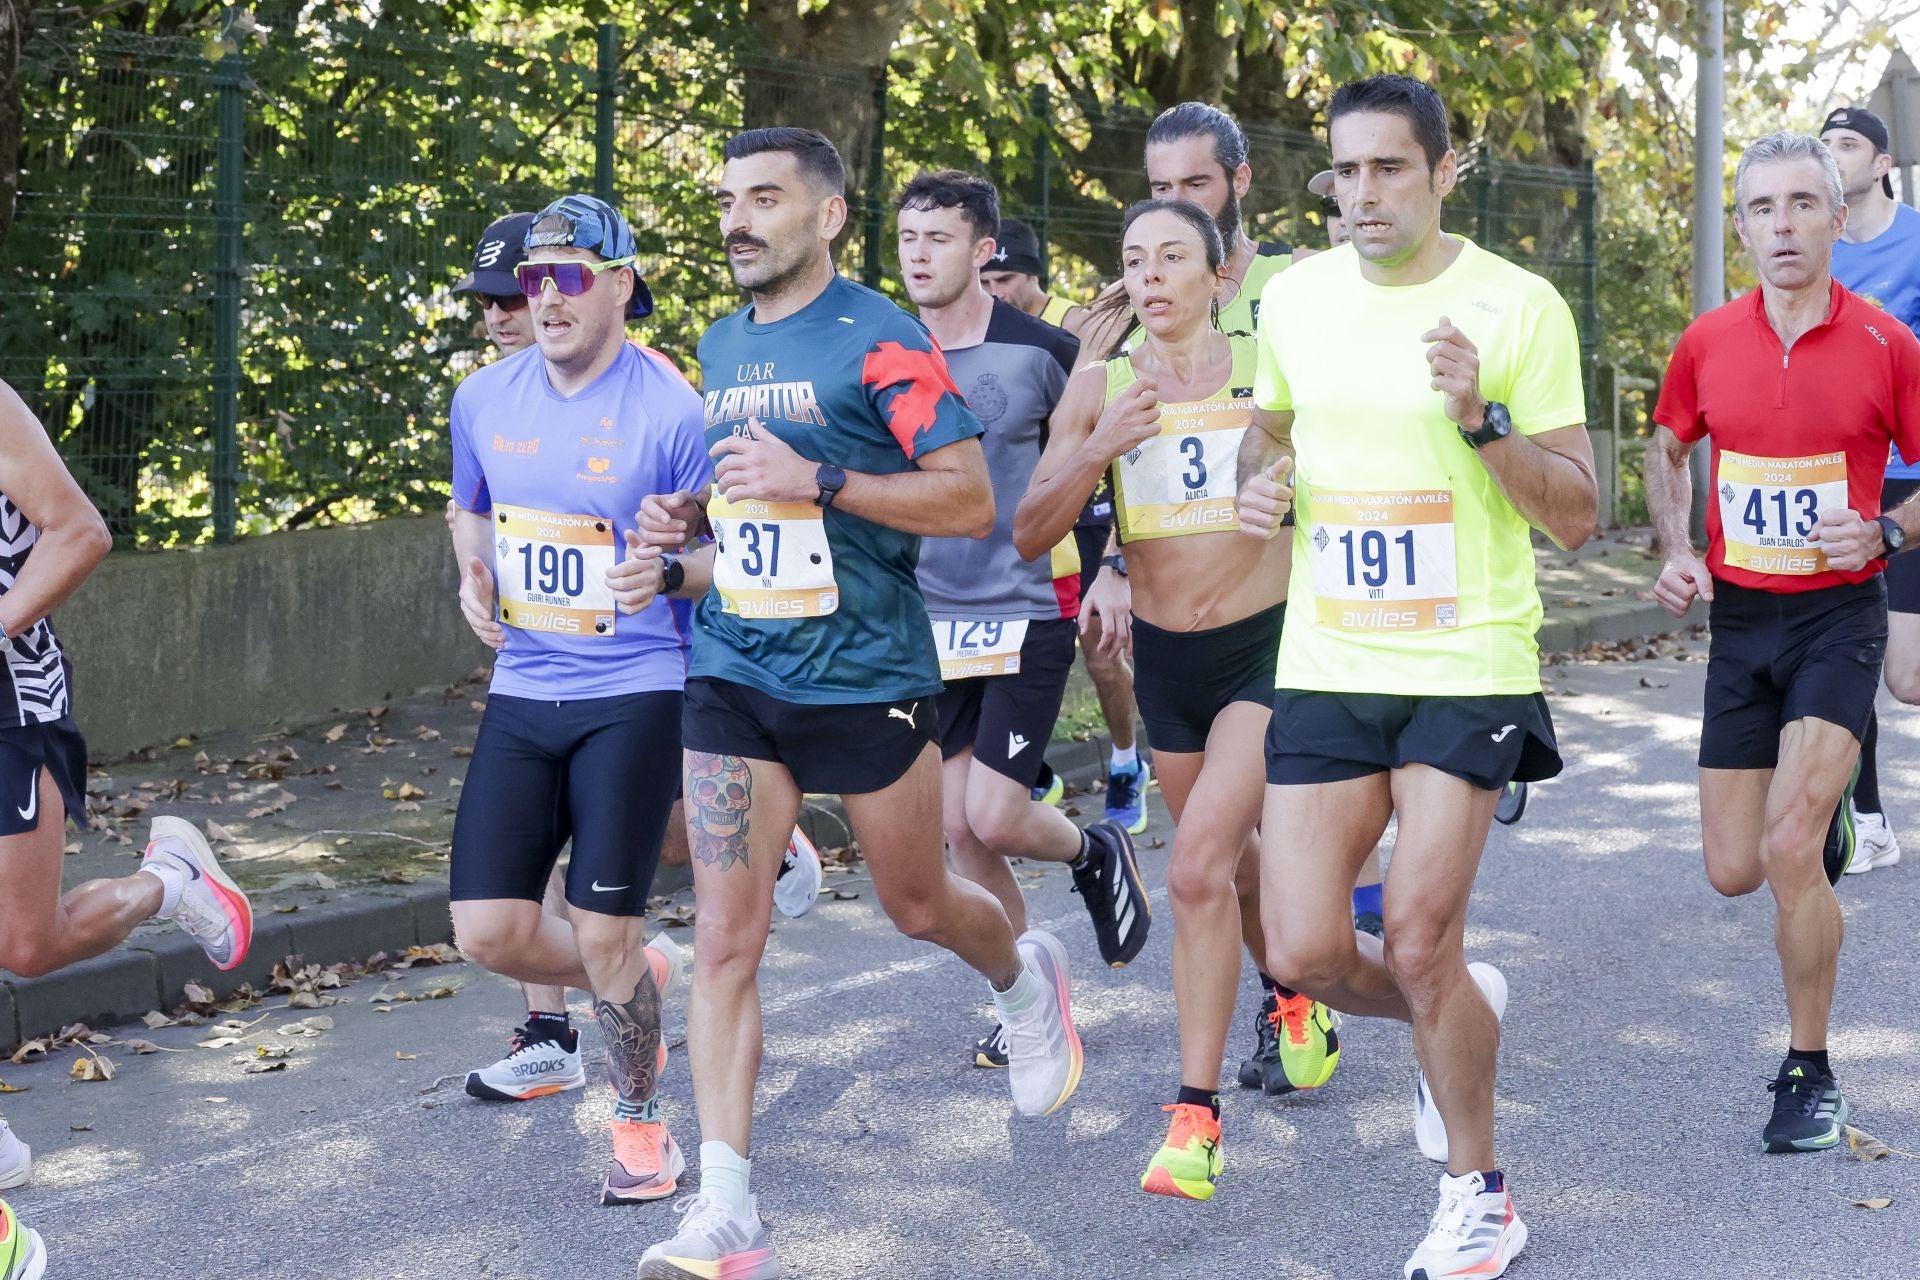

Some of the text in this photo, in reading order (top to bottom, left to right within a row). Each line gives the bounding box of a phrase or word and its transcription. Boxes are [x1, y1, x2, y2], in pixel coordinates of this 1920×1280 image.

[737, 362, 775, 382] UAR
[1161, 399, 1256, 417] DIA MARATÓN AVILÉ
[733, 422, 767, 440] RA
[1175, 419, 1205, 430] 2024
[1179, 436, 1208, 490] 3
[1743, 458, 1766, 469] MEDIA
[1767, 457, 1813, 470] MARATÓN
[1813, 454, 1843, 467] AVILÉS
[1764, 472, 1793, 483] 2024
[1185, 489, 1208, 501] ALICIA
[1334, 495, 1360, 505] MEDIA
[1361, 493, 1413, 506] MARATÓN
[1414, 492, 1450, 505] AVILÉS
[744, 504, 769, 515] 2024
[1357, 510, 1389, 521] 2024
[1743, 488, 1819, 537] 413
[517, 510, 539, 522] MEDIA
[540, 516, 581, 527] MARATÓN
[537, 527, 561, 539] 2024
[739, 522, 781, 577] 37
[1759, 537, 1805, 548] JUAN CARLOS
[1339, 529, 1416, 588] 191
[518, 543, 584, 598] 190
[527, 592, 571, 607] GUIRI RUNNER
[1368, 588, 1384, 600] VITI
[1341, 606, 1418, 629] avilés
[948, 620, 1004, 651] 129
[511, 1057, 565, 1078] BROOKS
